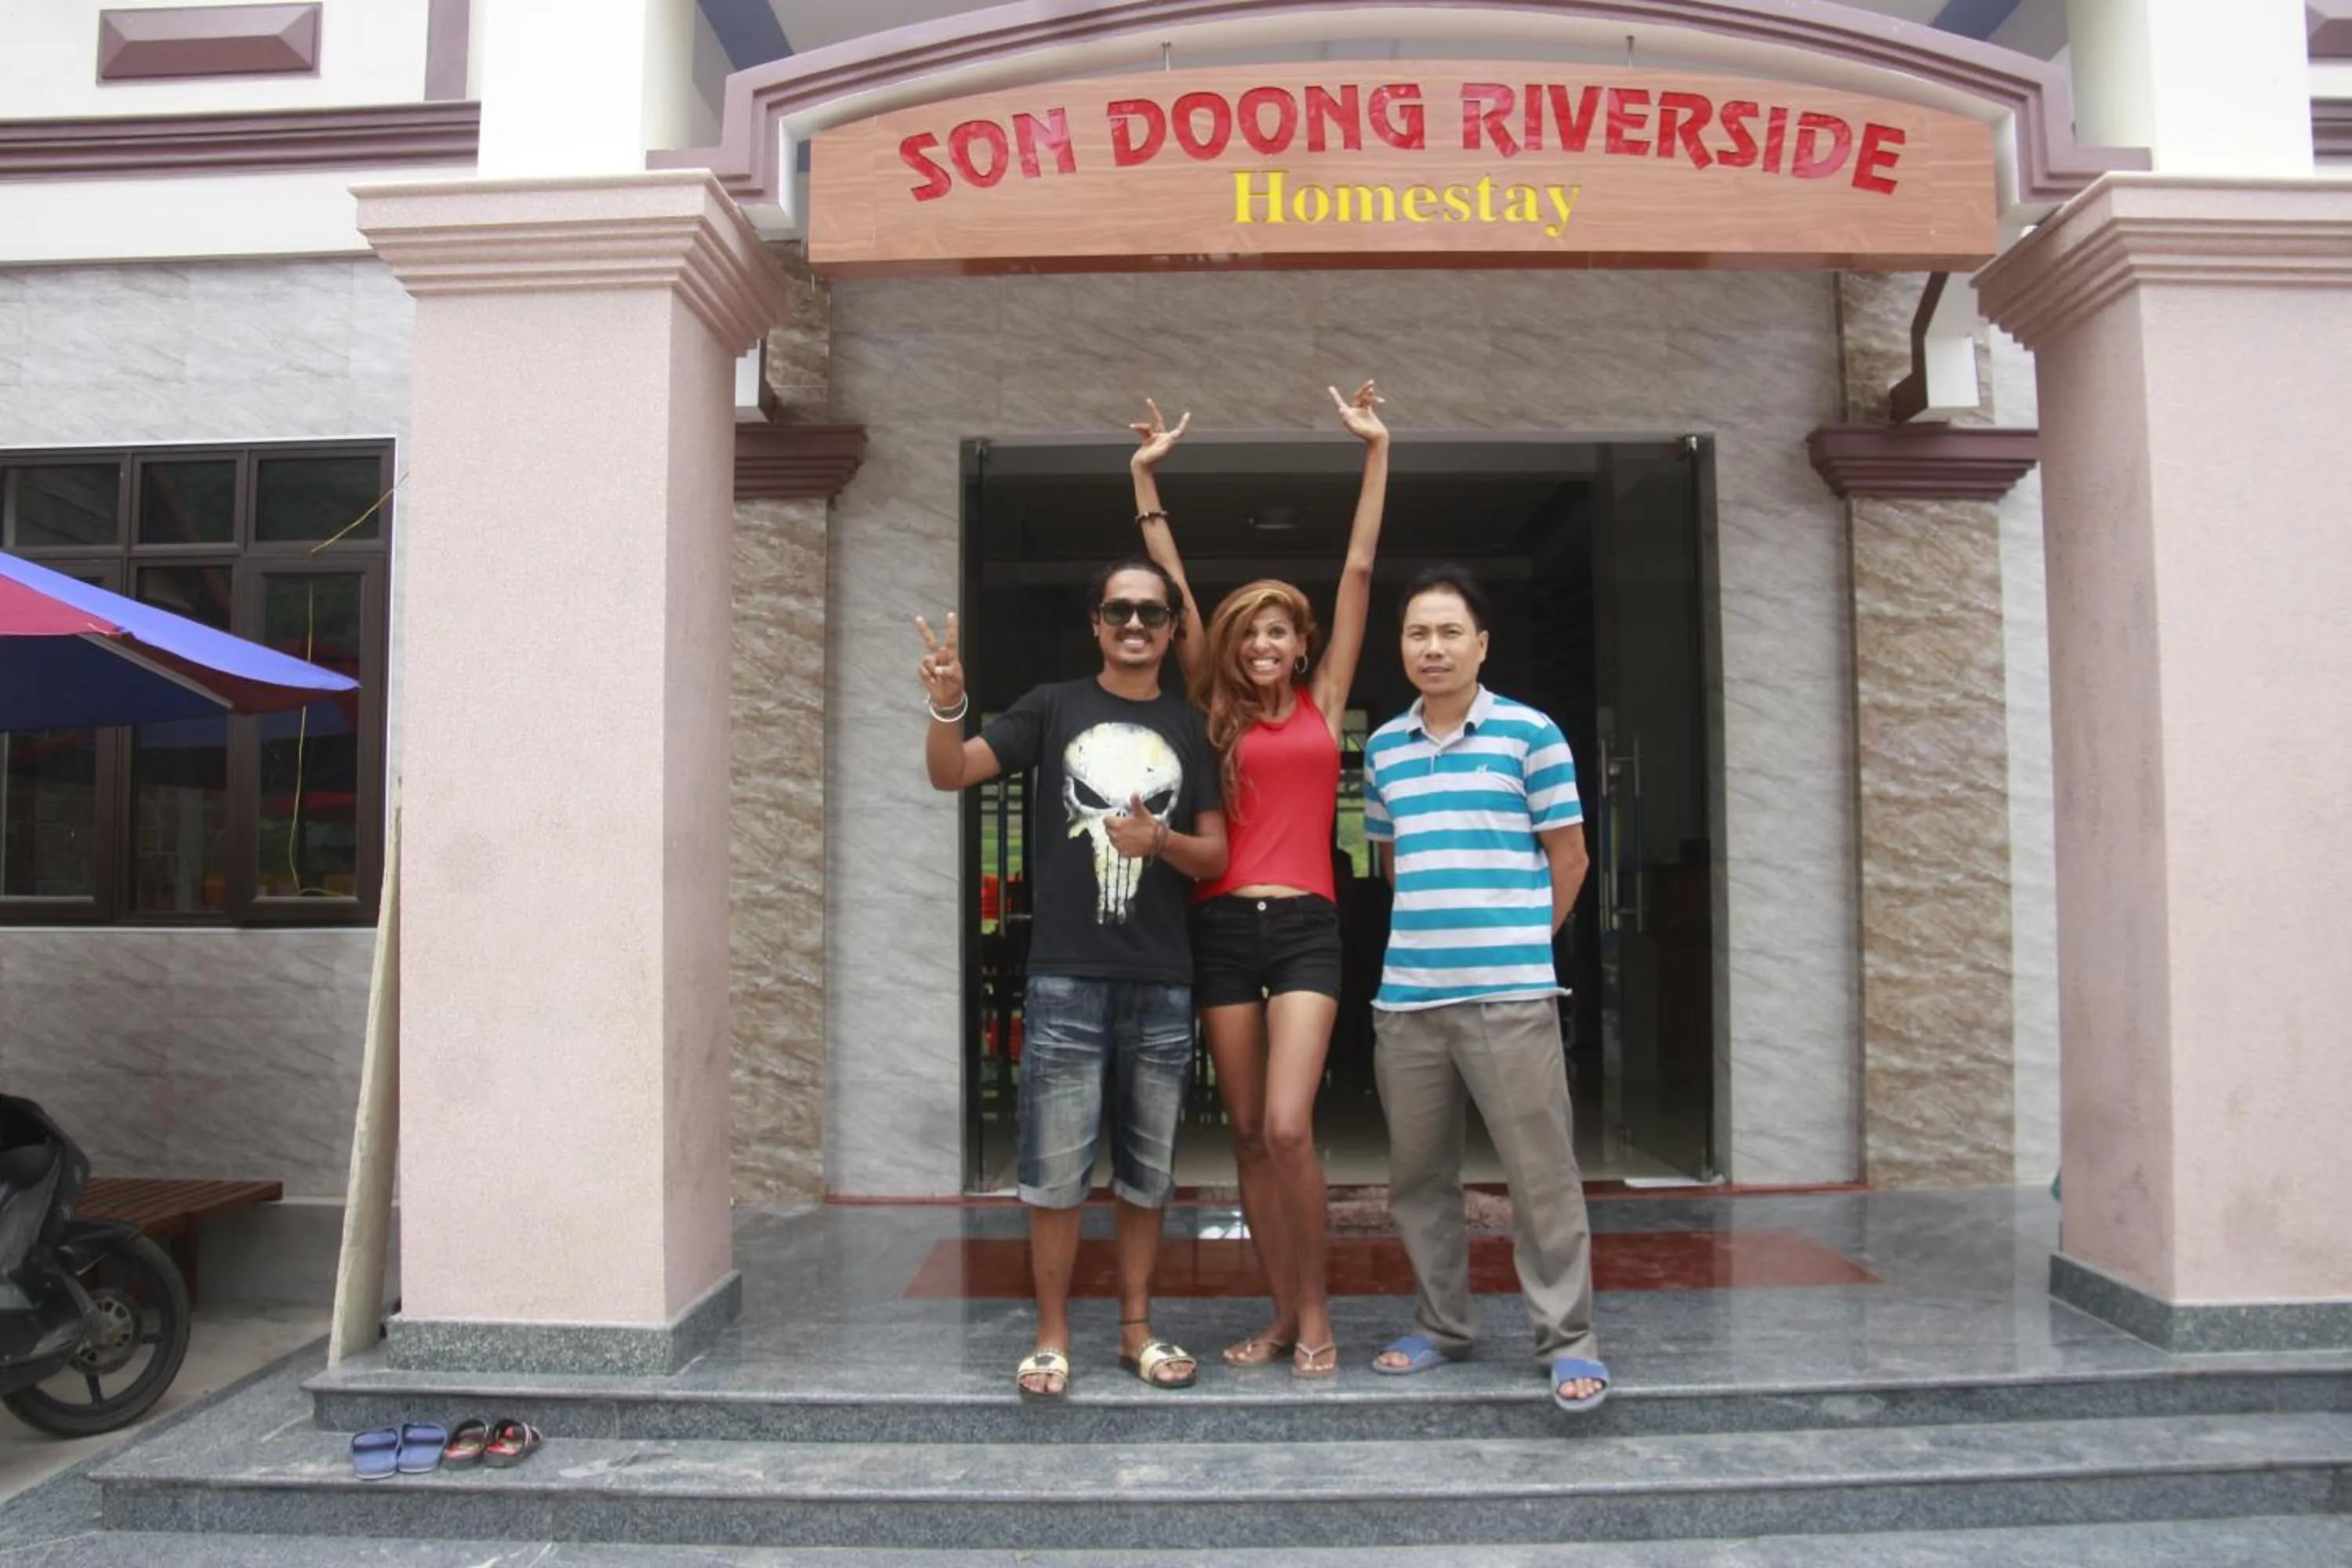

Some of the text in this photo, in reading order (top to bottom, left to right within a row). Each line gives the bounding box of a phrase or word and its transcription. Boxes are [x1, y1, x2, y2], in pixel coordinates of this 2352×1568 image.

[899, 82, 1906, 202] SON DOONG RIVERSIDE
[1230, 169, 1581, 238] Homestay
